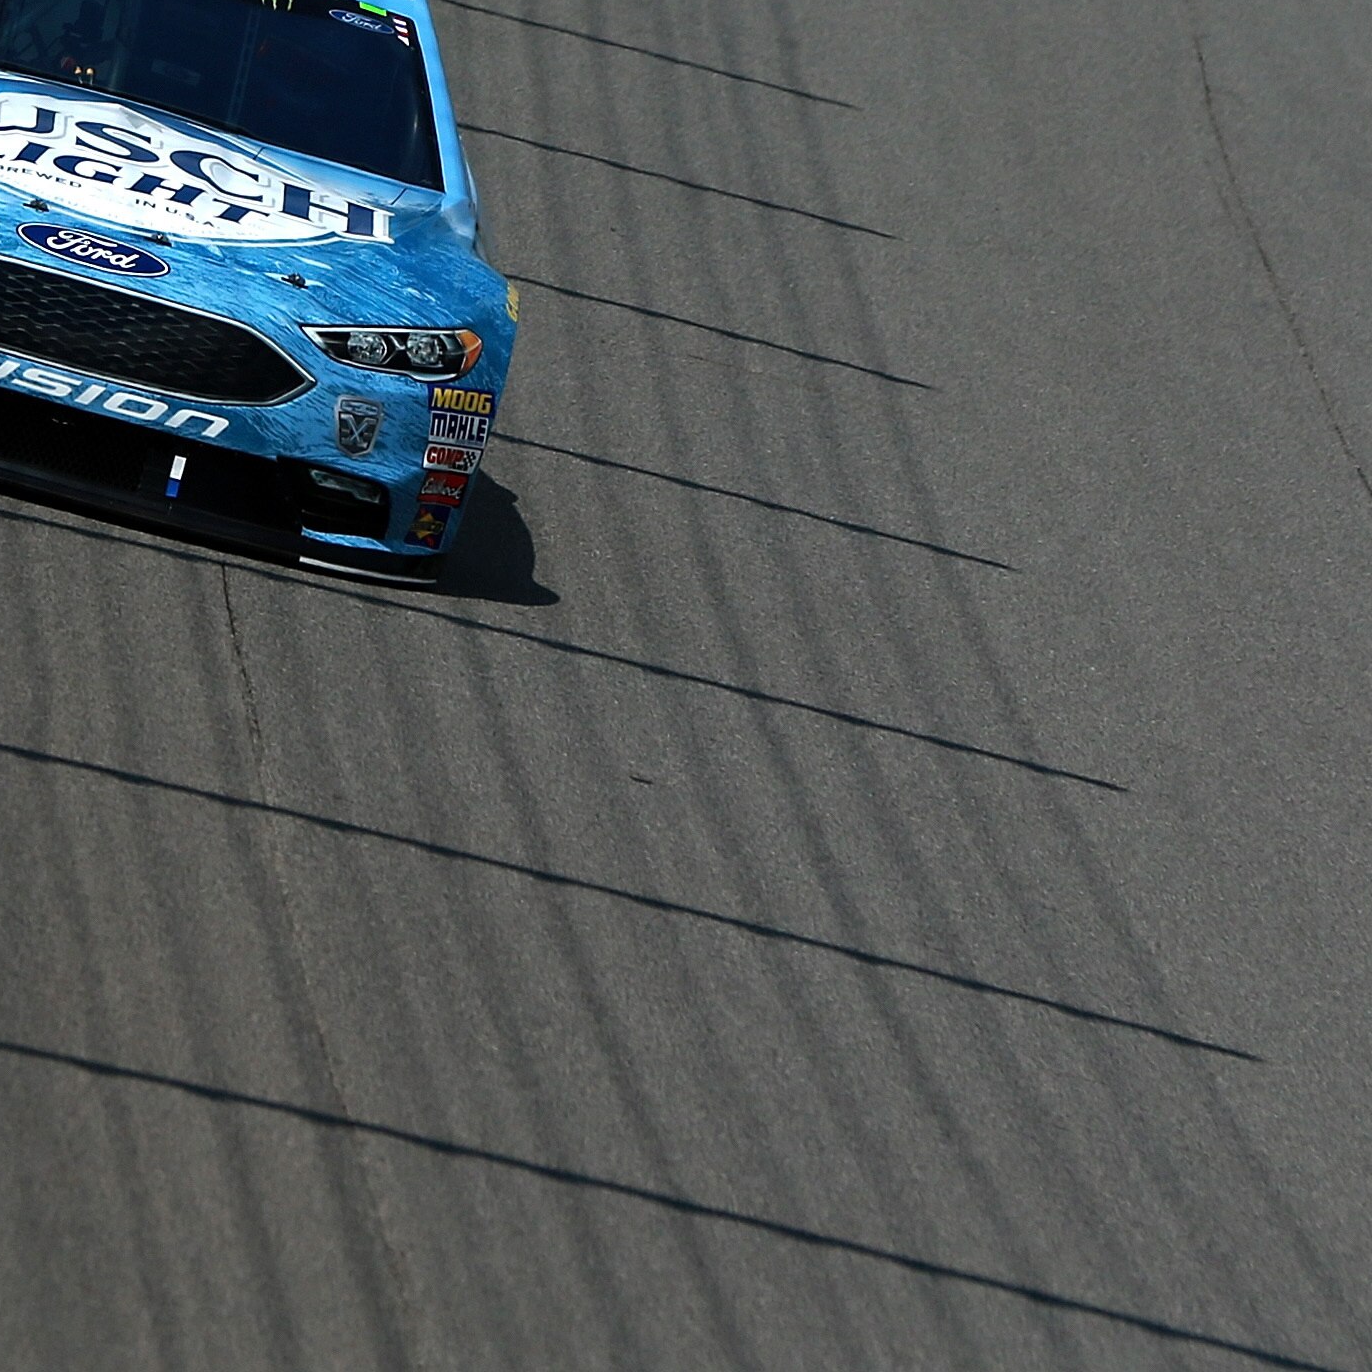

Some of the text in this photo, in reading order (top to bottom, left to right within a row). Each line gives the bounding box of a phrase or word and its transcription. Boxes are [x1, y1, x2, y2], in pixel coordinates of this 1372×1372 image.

[341, 10, 384, 30] Ford
[135, 198, 156, 209] IN
[46, 229, 140, 269] Ford
[431, 387, 493, 414] MOOG
[430, 414, 488, 443] MAHLE
